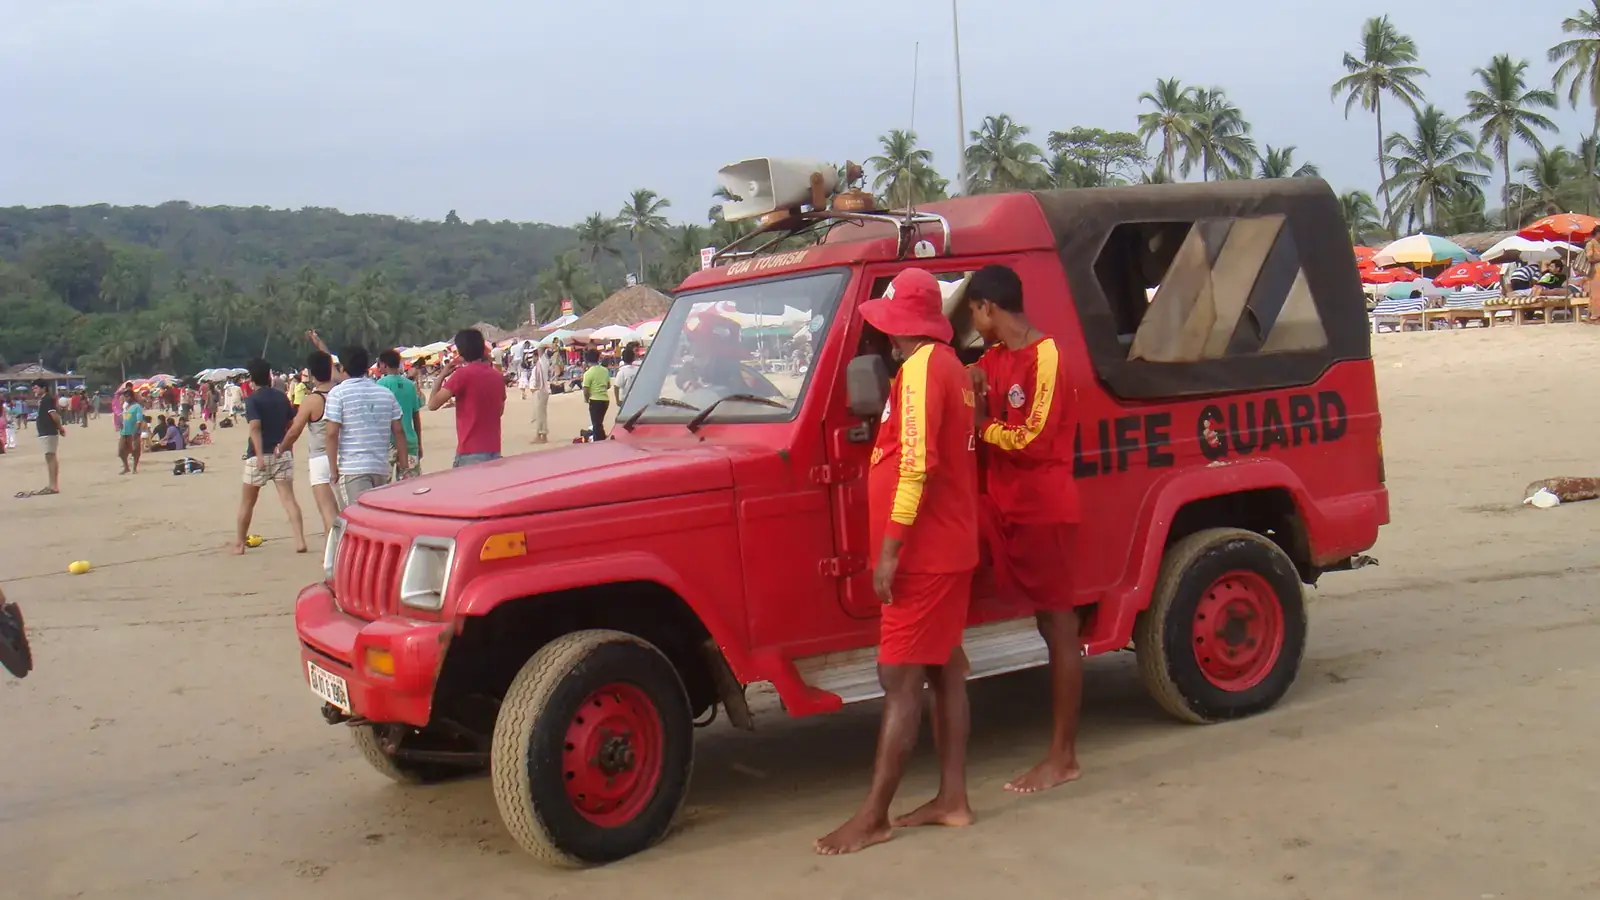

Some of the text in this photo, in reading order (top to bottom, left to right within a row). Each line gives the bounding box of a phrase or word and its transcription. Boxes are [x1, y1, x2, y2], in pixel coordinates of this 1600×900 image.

[726, 250, 809, 276] GOA TOURISM
[1073, 390, 1348, 479] LIFE GUARD
